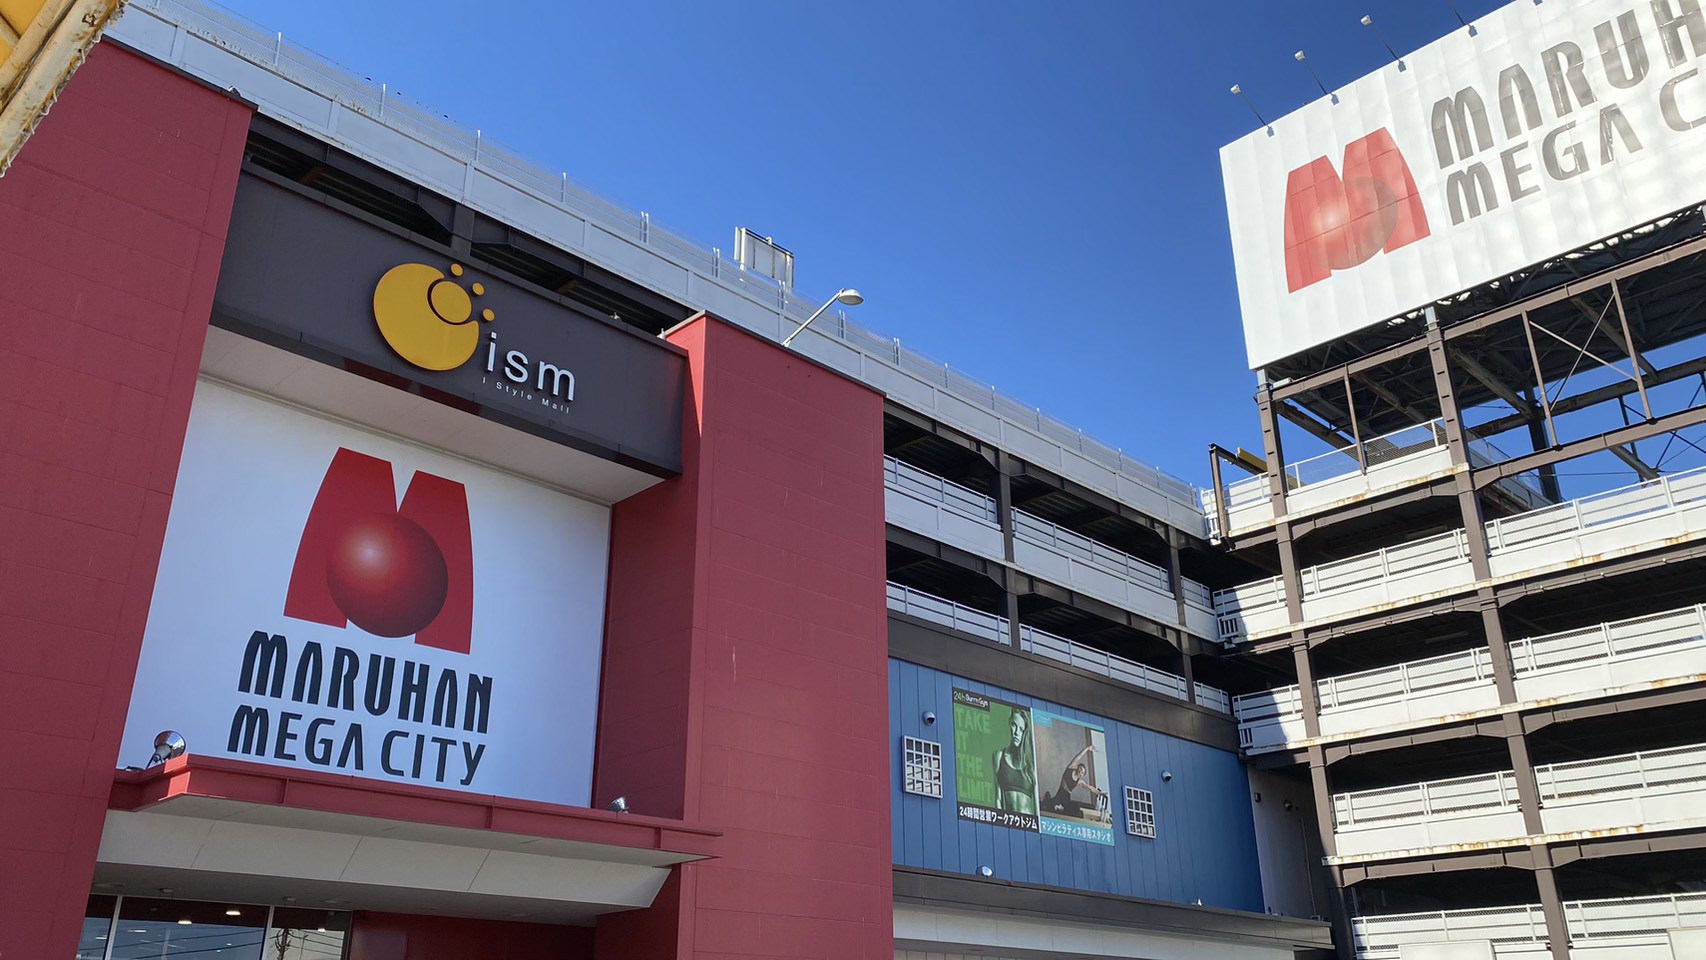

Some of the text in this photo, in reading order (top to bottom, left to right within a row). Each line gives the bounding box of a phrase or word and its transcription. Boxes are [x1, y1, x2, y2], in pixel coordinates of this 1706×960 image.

[1446, 103, 1642, 226] MEGA
[487, 331, 575, 402] ism
[496, 381, 533, 401] Style
[541, 398, 570, 414] Mall
[237, 630, 493, 734] MARUHAN
[955, 706, 991, 735] TAKE
[226, 704, 486, 786] MEGA CITY
[957, 729, 968, 751] IT
[957, 752, 984, 778] THE
[959, 776, 993, 803] LIMIT
[959, 806, 1038, 830] 24時間営業ワークアウトジム
